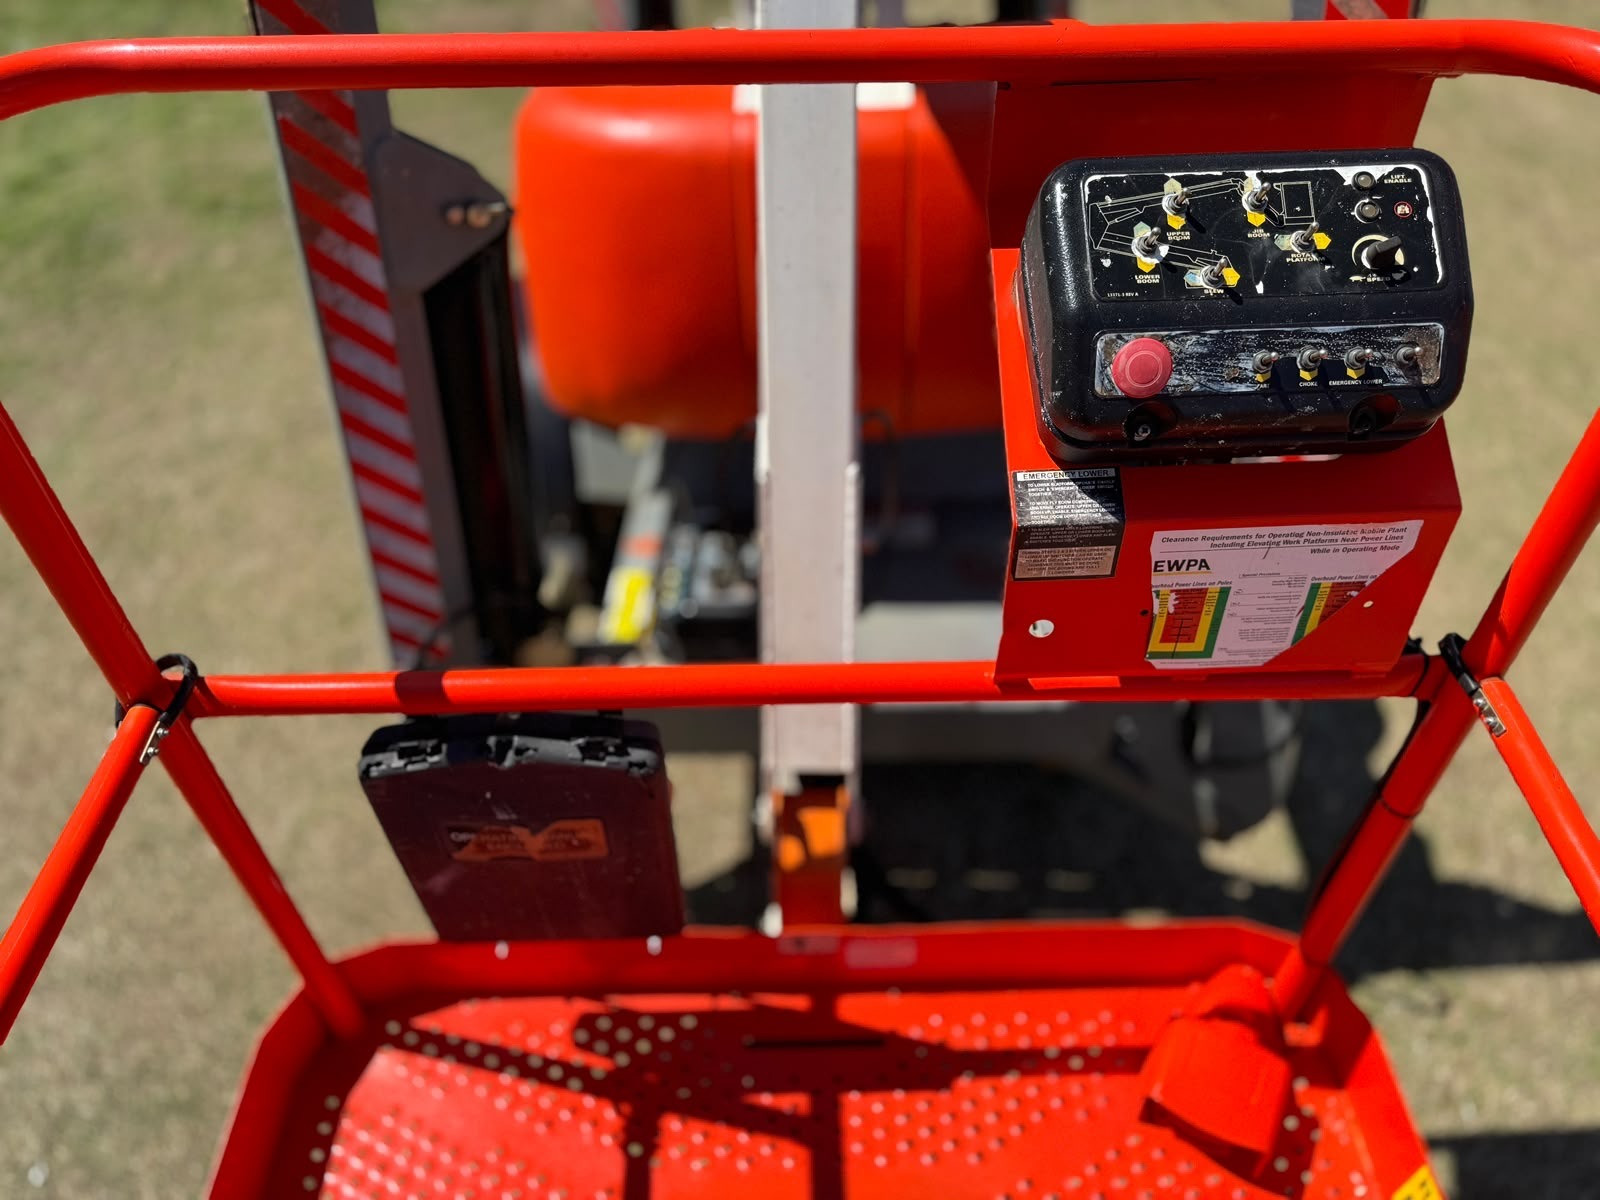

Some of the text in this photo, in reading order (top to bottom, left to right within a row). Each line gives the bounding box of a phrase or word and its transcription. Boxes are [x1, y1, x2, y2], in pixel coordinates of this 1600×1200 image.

[1023, 471, 1076, 480] EMERGENCY
[1201, 533, 1253, 542] Requirements
[1268, 531, 1304, 540] Operating
[1246, 539, 1281, 547] Elevating
[1153, 558, 1211, 572] EWPA
